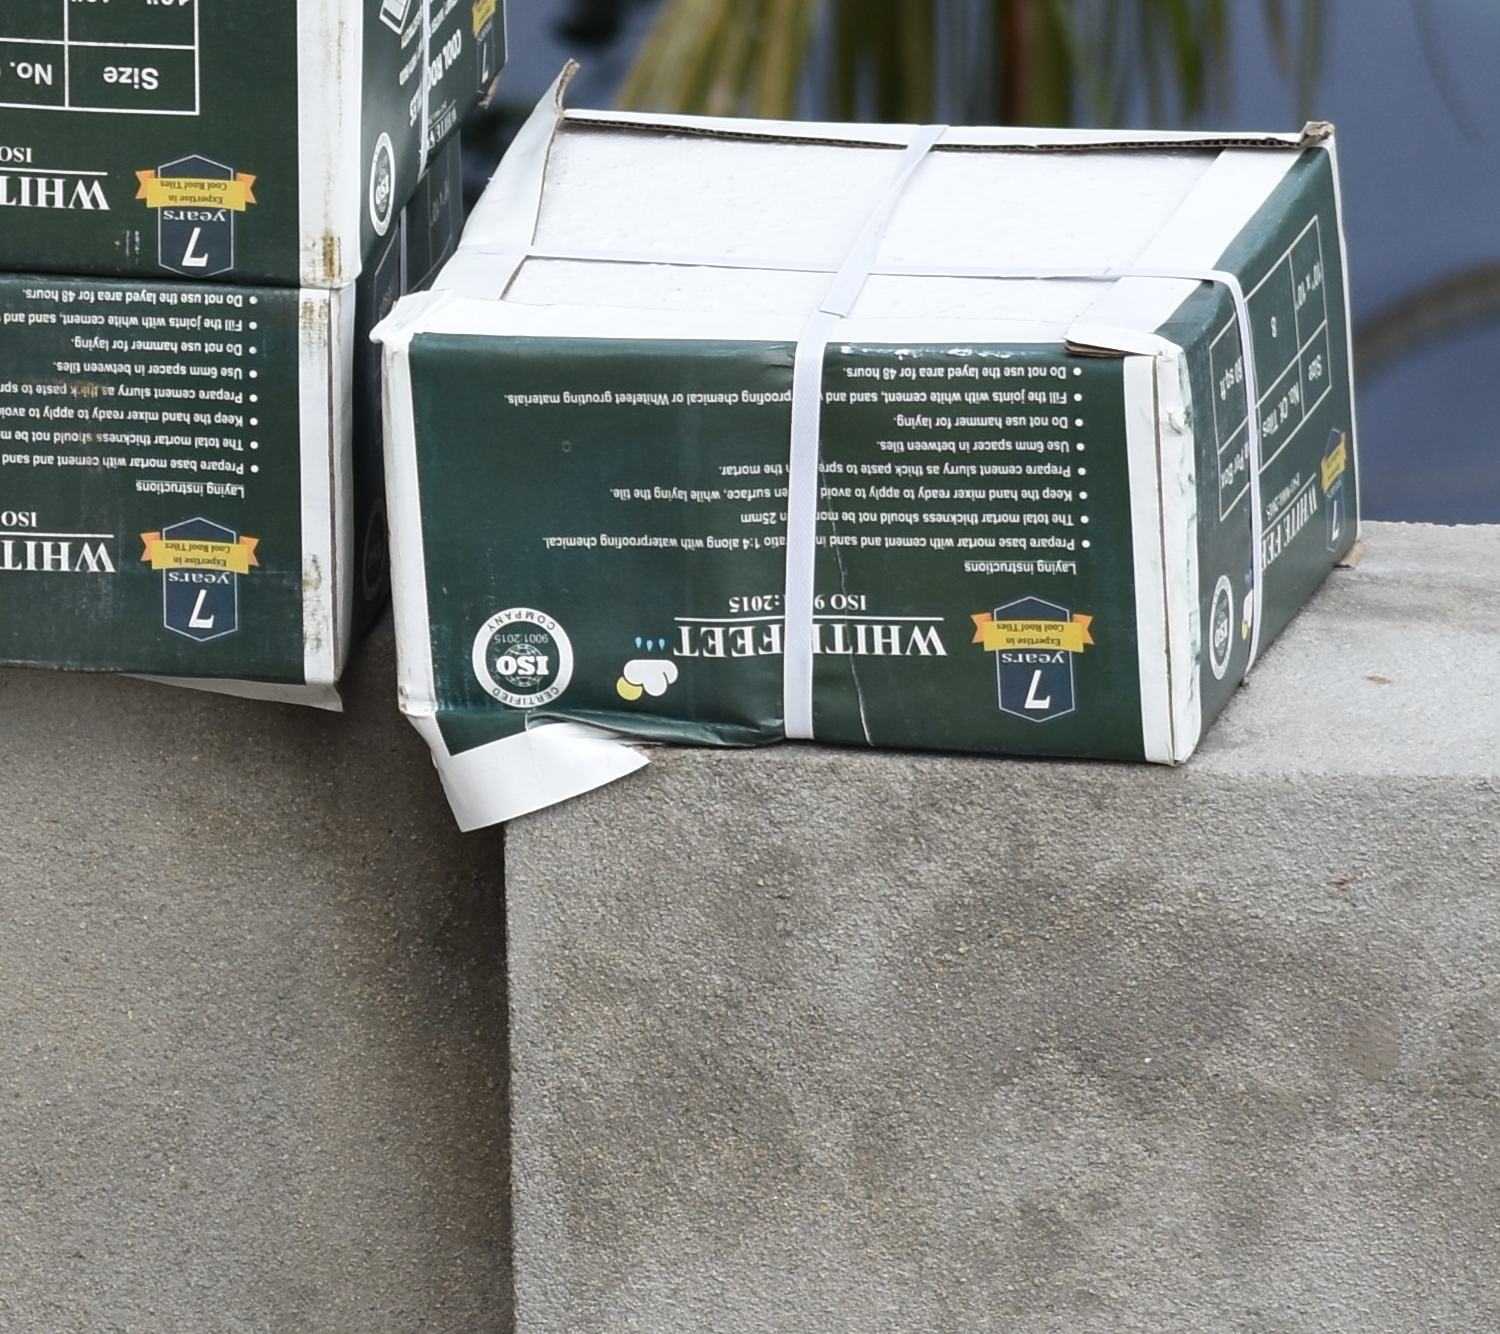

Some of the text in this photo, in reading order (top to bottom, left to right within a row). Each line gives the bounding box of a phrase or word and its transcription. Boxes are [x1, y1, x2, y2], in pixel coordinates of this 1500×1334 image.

[102, 65, 160, 91] Size
[892, 413, 1069, 430] Do not use hammer for laying.
[0, 510, 37, 528] ISO
[963, 559, 1077, 576] Laying instructions
[168, 571, 231, 585] years
[187, 588, 215, 629] 7
[672, 623, 783, 657] FEET
[1000, 650, 1065, 667] years
[1023, 669, 1052, 710] 7
